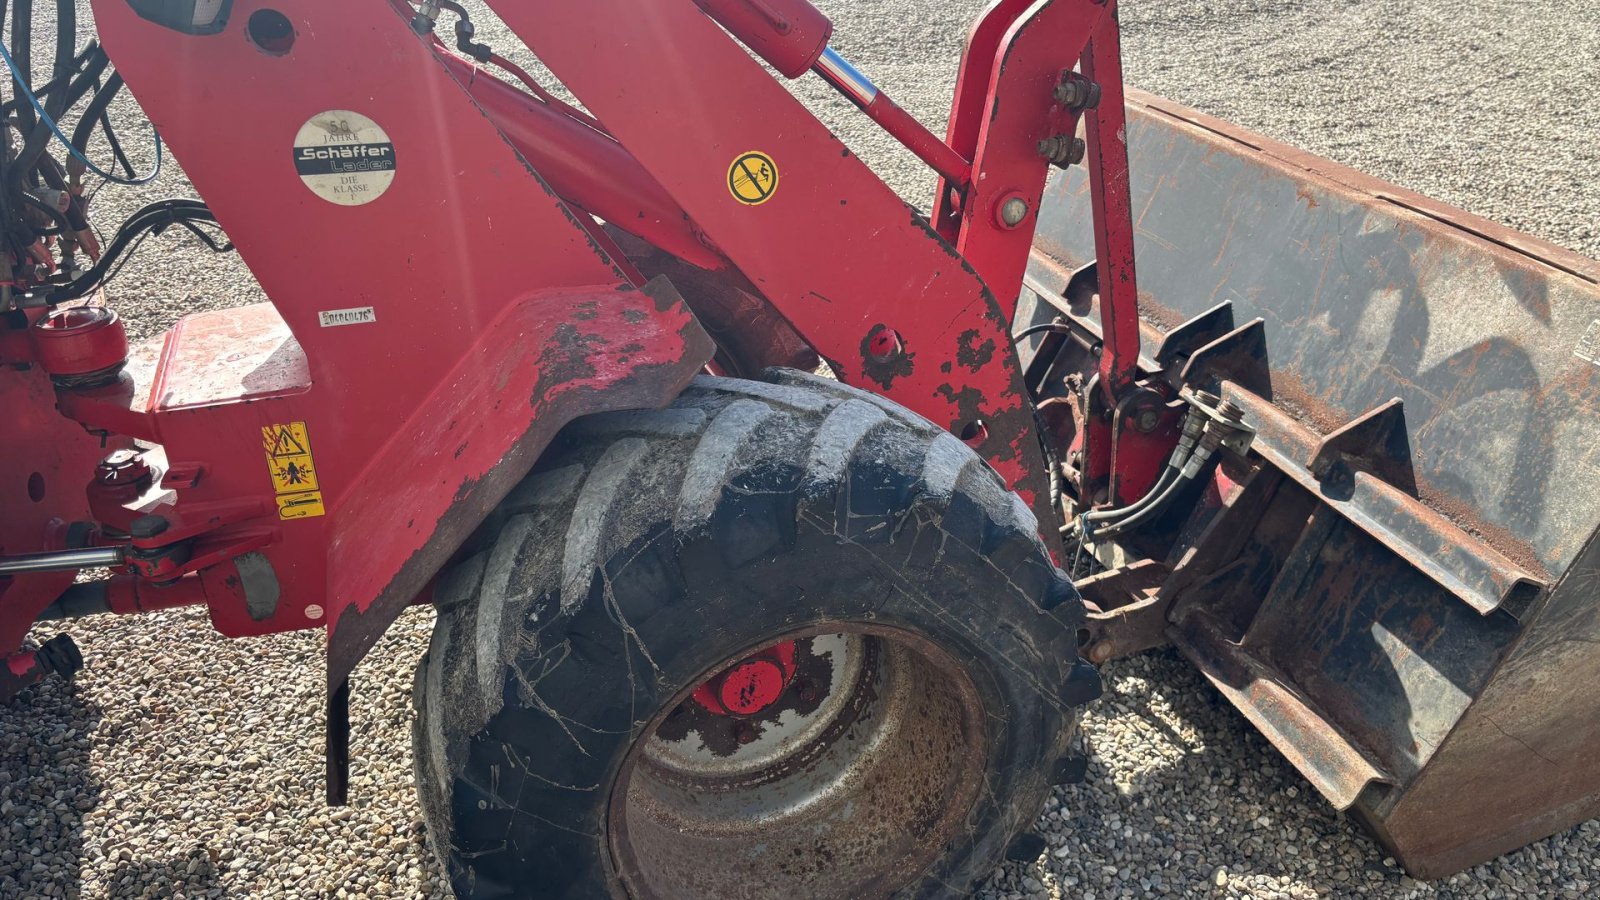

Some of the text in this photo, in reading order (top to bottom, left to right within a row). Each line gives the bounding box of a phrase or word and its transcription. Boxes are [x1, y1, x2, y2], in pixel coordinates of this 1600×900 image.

[323, 133, 360, 144] JAHRE
[299, 146, 390, 160] Schäffer
[330, 158, 392, 172] Lader
[340, 175, 359, 185] DIE
[333, 184, 369, 194] KLASSE
